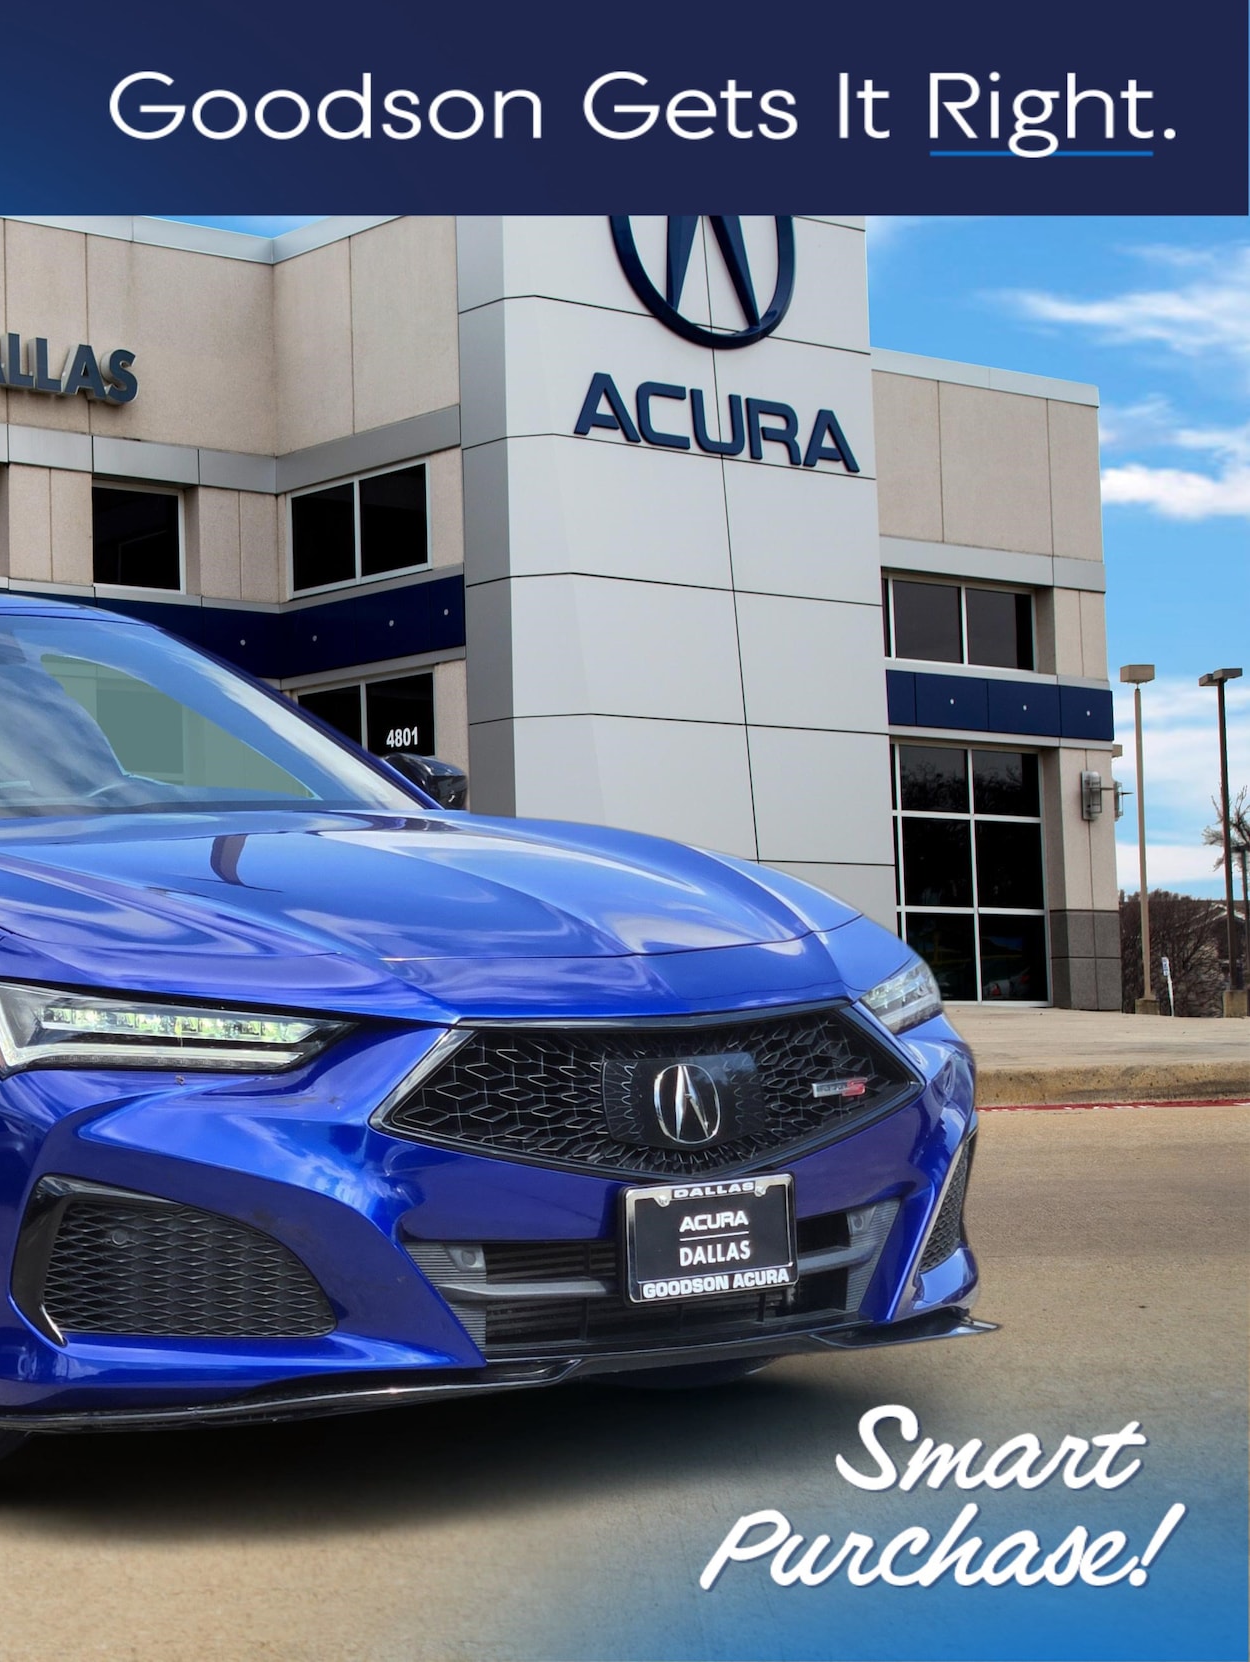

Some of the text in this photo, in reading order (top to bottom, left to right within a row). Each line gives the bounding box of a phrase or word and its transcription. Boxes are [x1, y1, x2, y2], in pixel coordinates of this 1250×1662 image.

[573, 371, 861, 474] ACURA
[386, 725, 418, 748] 4801
[673, 1181, 756, 1199] DALLAS
[678, 1210, 749, 1233] ACURA
[679, 1239, 751, 1267] DALLAS
[642, 1267, 790, 1299] GOODSON ACURA
